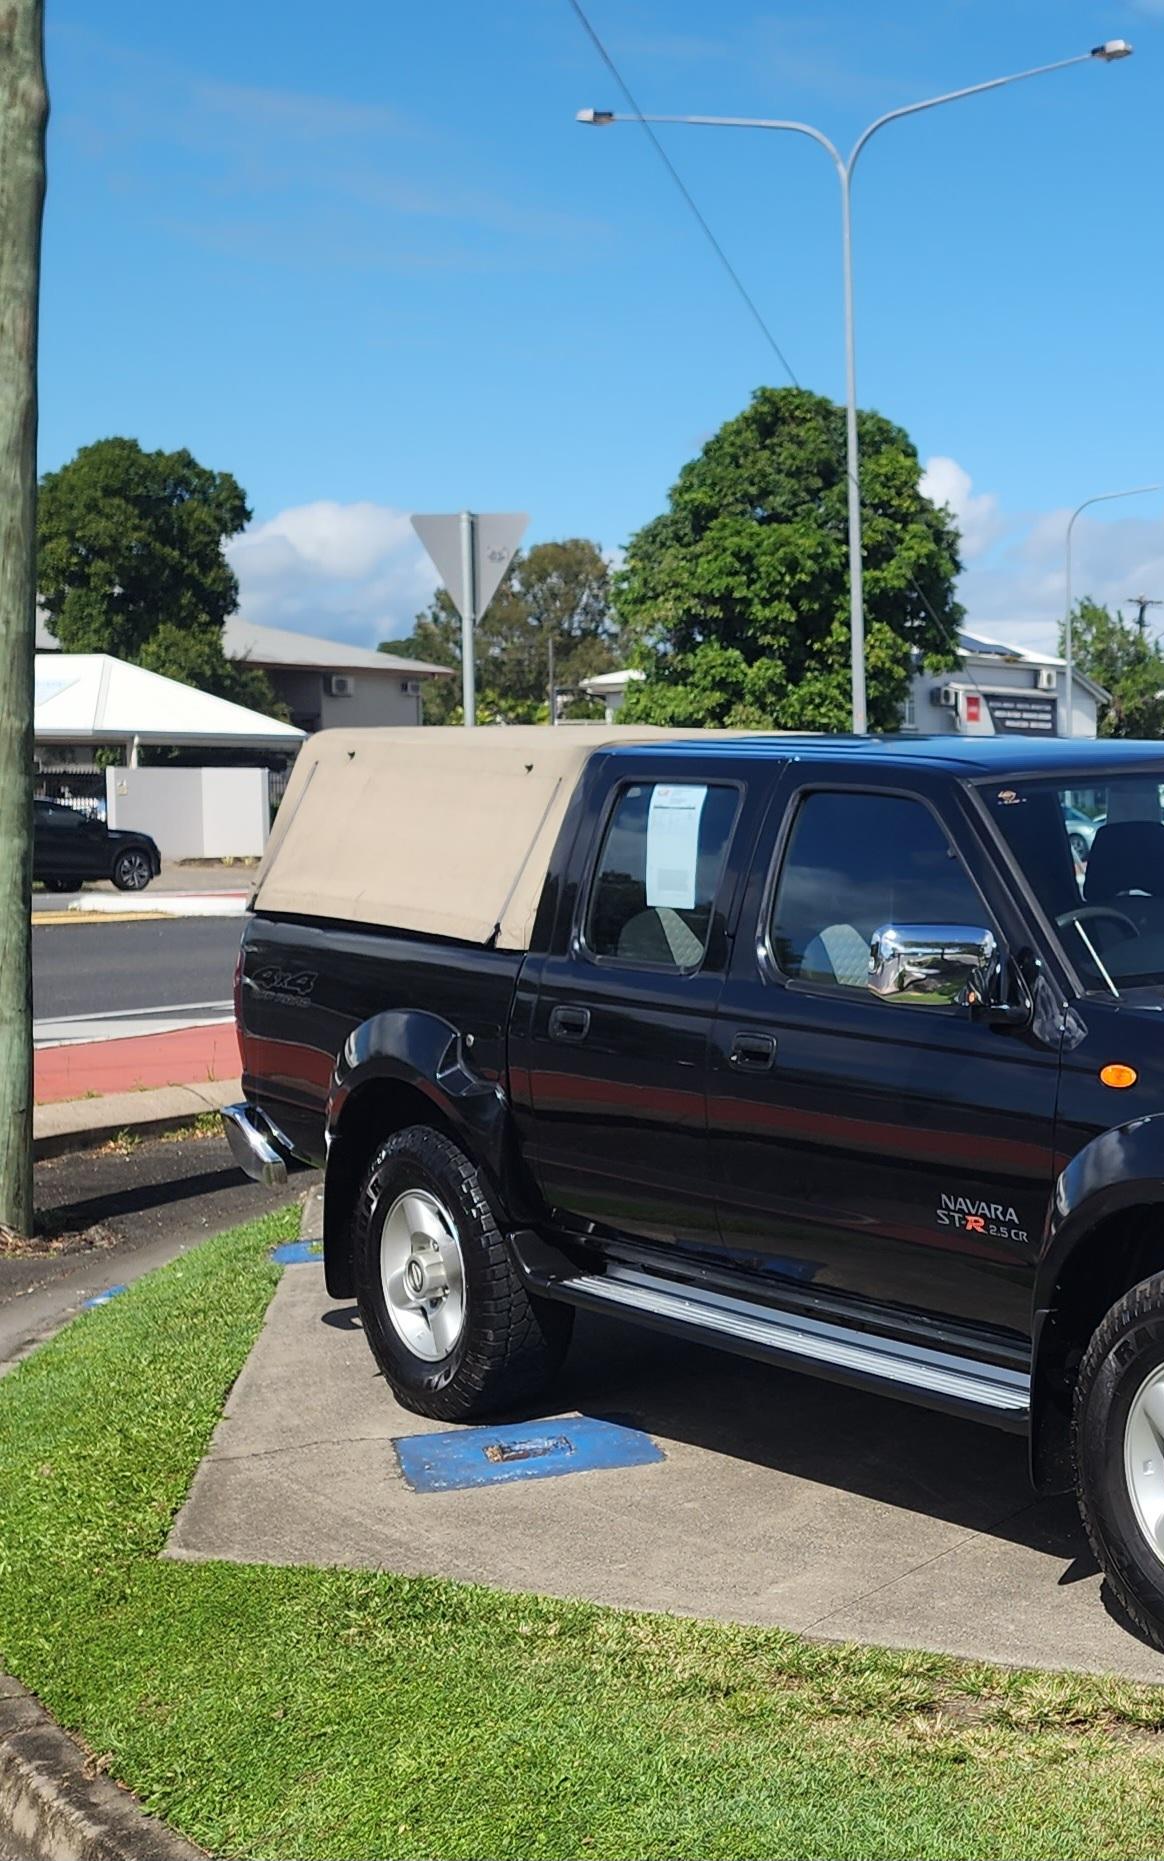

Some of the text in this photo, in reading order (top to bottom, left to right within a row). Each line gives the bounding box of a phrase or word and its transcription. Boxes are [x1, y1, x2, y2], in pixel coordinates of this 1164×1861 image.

[940, 1193, 1020, 1225] NAVARA
[936, 1209, 1030, 1243] ST-R 2.5 CR
